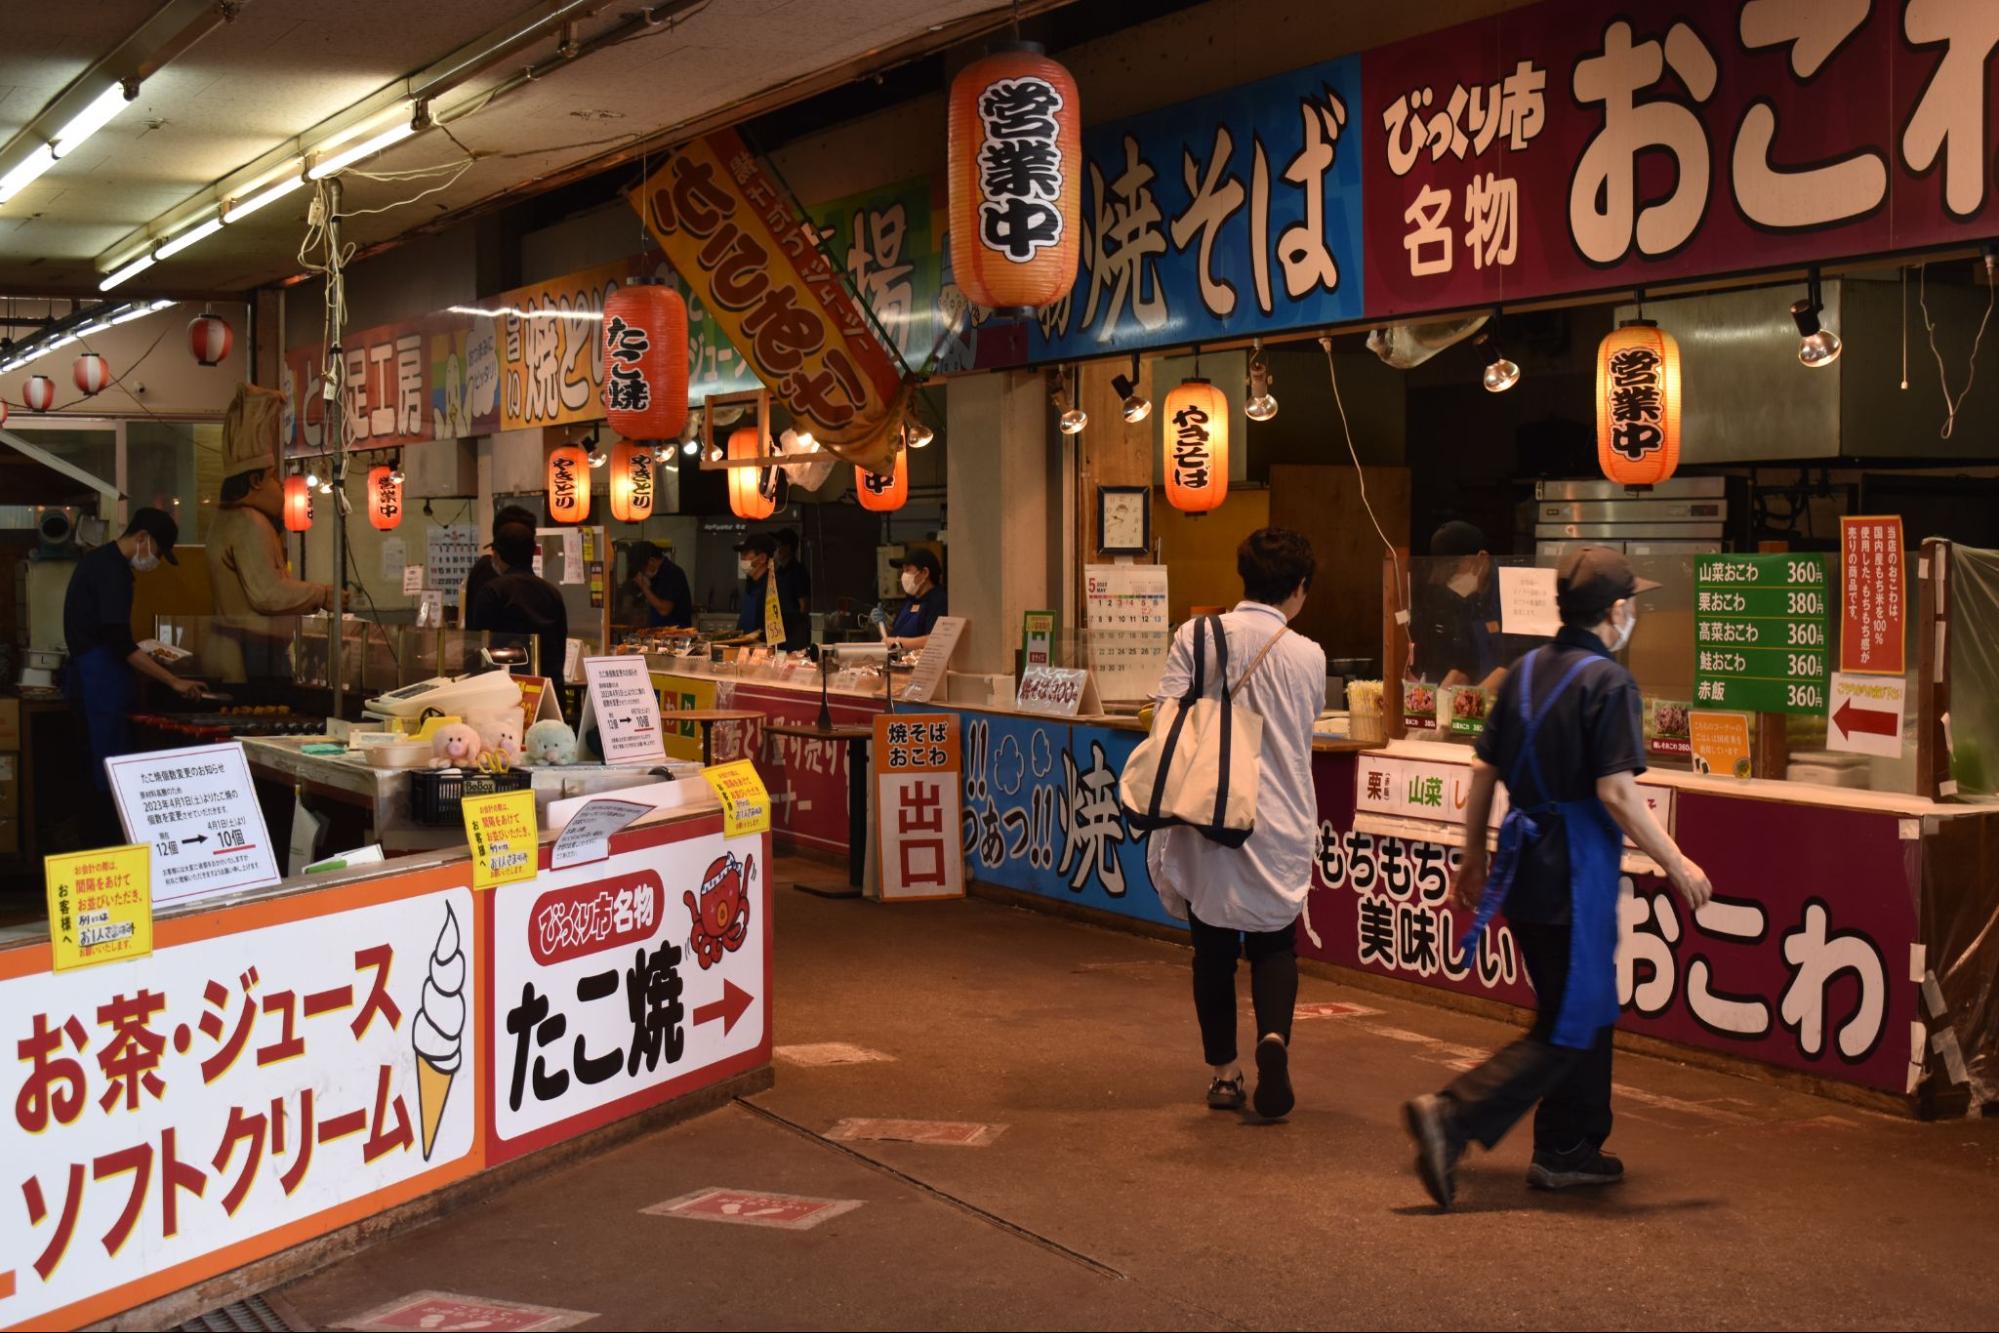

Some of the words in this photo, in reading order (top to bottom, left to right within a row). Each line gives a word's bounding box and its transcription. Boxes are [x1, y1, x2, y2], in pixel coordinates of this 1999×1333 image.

[1382, 58, 1547, 177] びっくり市
[981, 78, 1061, 260] 営業中
[1082, 80, 1347, 343] 焼そば
[1403, 171, 1518, 278] 名物
[606, 315, 651, 413] たこ焼
[1610, 348, 1663, 461] 営業中
[1173, 405, 1208, 488] やきそば
[1088, 578, 1096, 593] 5
[1699, 592, 1746, 611] 栗おこわ
[1700, 562, 1758, 582] 山菜おこわ
[1699, 622, 1758, 642] 高菜おこわ
[1700, 651, 1746, 672] 鮭おこわ
[1698, 680, 1725, 701] 赤飯
[888, 722, 947, 744] 焼そば
[889, 746, 947, 769] おこわ
[1367, 772, 1383, 800] 栗
[1408, 775, 1443, 808] 山菜
[156, 840, 179, 857] 12個
[217, 829, 245, 848] 10個
[899, 780, 947, 888] 出口
[538, 892, 613, 956] びっくり市
[613, 883, 655, 934] 名物
[1358, 900, 1516, 988] 美味しい
[15, 943, 402, 1134] お茶・ジュース
[506, 940, 684, 1112] たこ焼
[21, 1064, 415, 1283] ソフトクリーム
